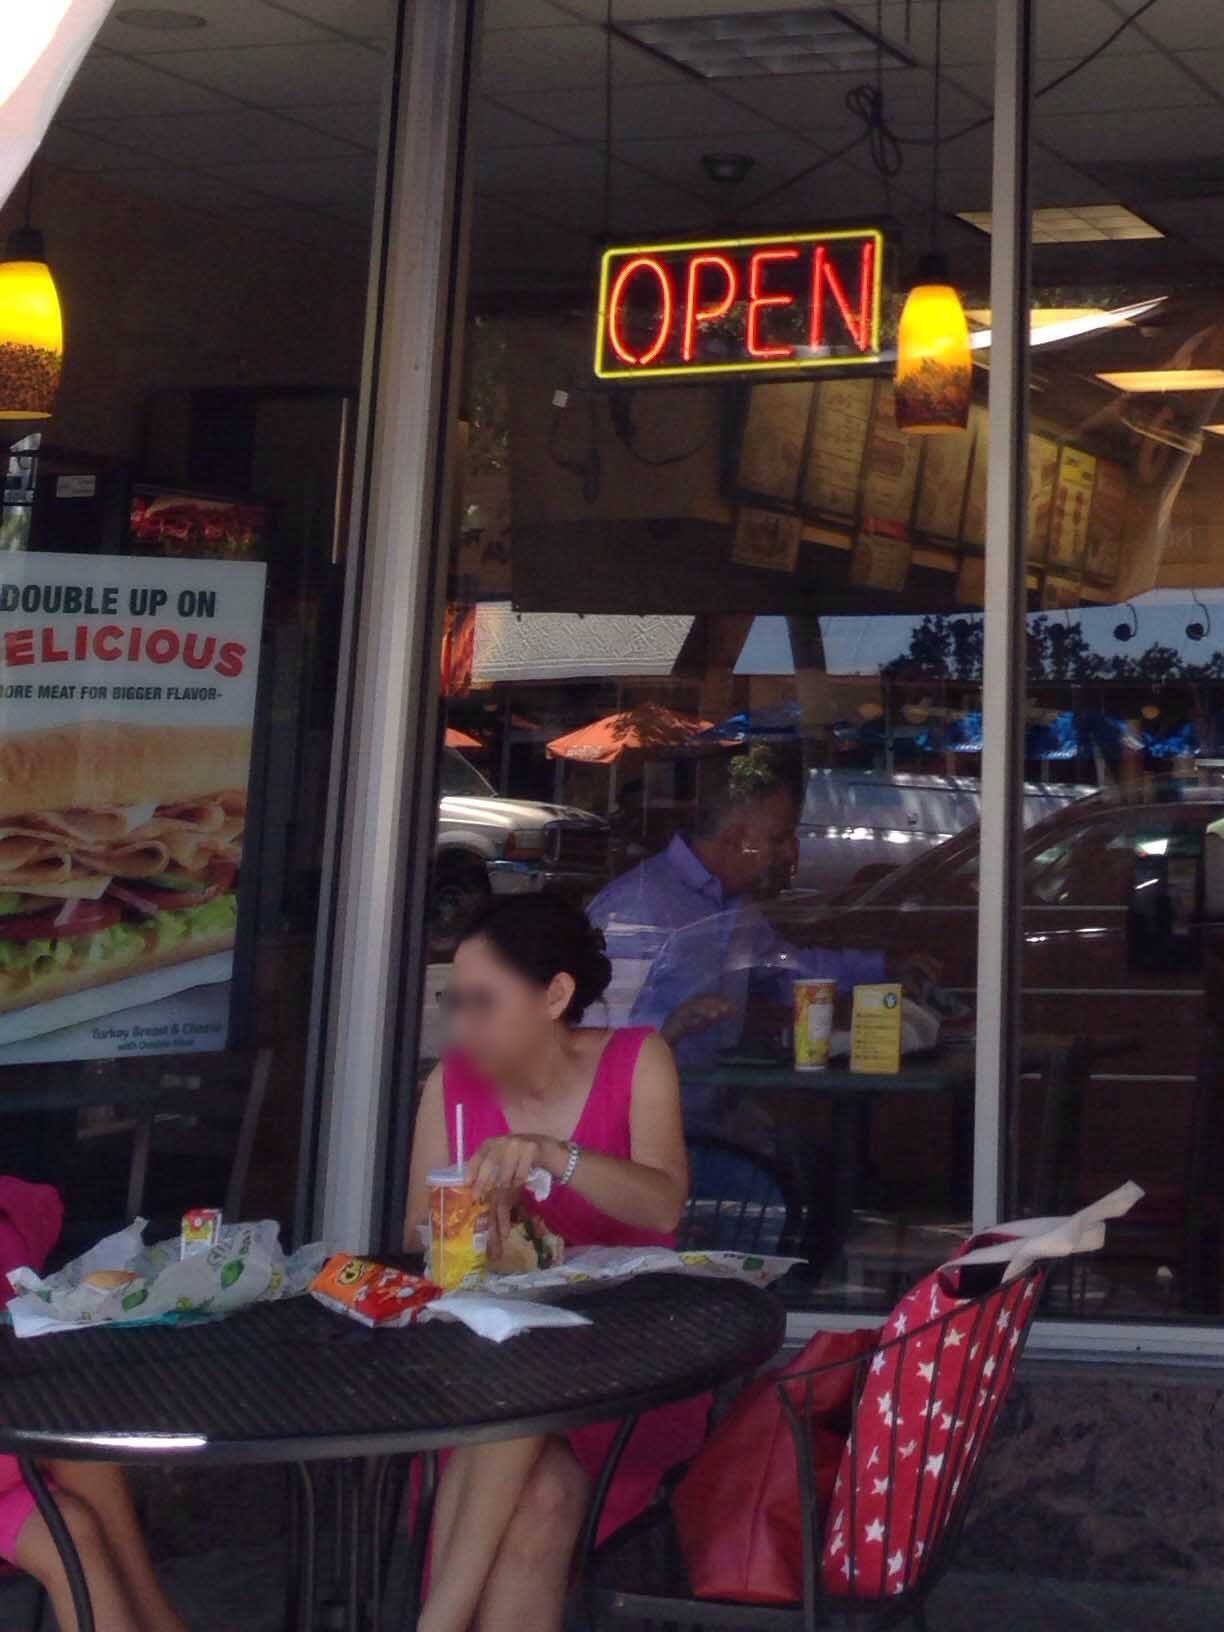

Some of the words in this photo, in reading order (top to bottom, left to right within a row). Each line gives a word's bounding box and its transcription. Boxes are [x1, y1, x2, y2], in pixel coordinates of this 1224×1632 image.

[609, 242, 876, 365] OPEN
[0, 584, 119, 615] DOUBLE
[129, 588, 168, 617] UP
[177, 590, 217, 618] ON
[4, 625, 247, 677] ELICIOUS
[38, 685, 75, 699] MEAT
[80, 685, 108, 700] FOR
[113, 686, 162, 700] BIGGER
